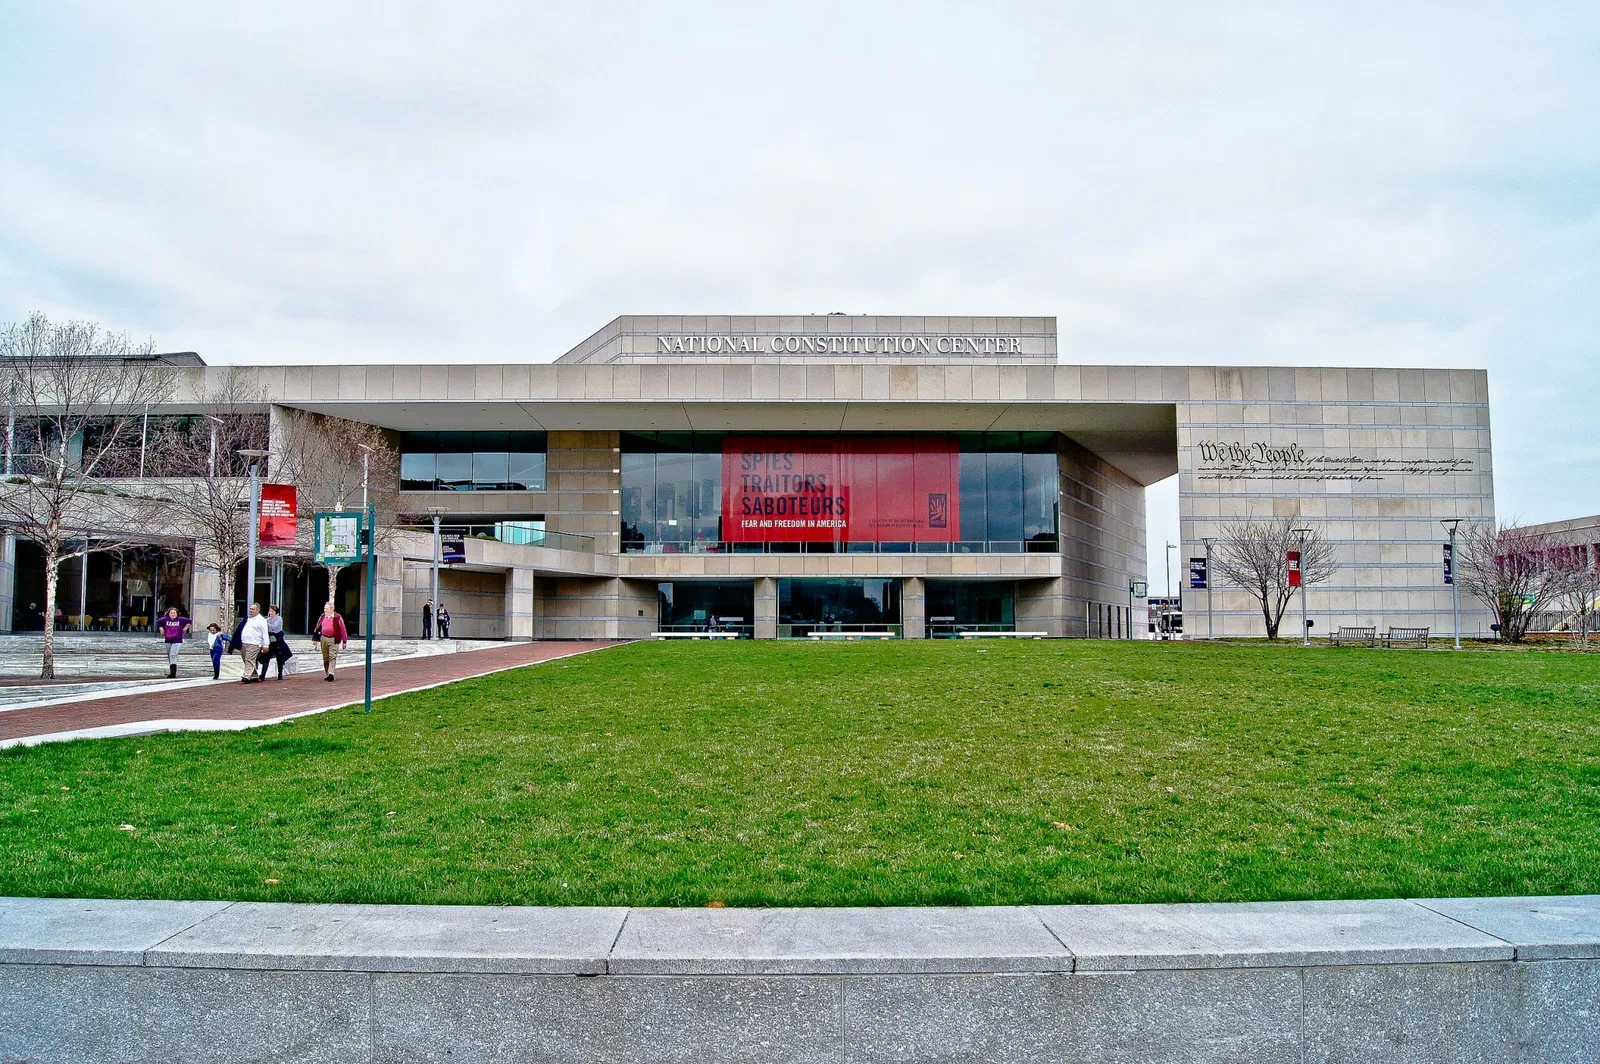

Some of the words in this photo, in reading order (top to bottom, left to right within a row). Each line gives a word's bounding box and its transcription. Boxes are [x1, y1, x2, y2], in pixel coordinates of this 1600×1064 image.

[656, 336, 764, 353] NATIONAL
[770, 336, 932, 353] CONSTITUTION
[936, 336, 1022, 353] CENTER
[741, 451, 794, 471] SPIES
[1197, 439, 1227, 464] We
[1228, 441, 1254, 465] the
[1250, 441, 1308, 467] People
[741, 474, 827, 493] TRAITORS
[741, 496, 846, 516] SABOTEURS
[930, 498, 945, 513] SPY
[741, 520, 758, 528] FEAR
[759, 520, 773, 528] AND
[774, 520, 806, 528] FREEDOM
[808, 520, 815, 528] IN
[816, 520, 847, 528] AMERICA
